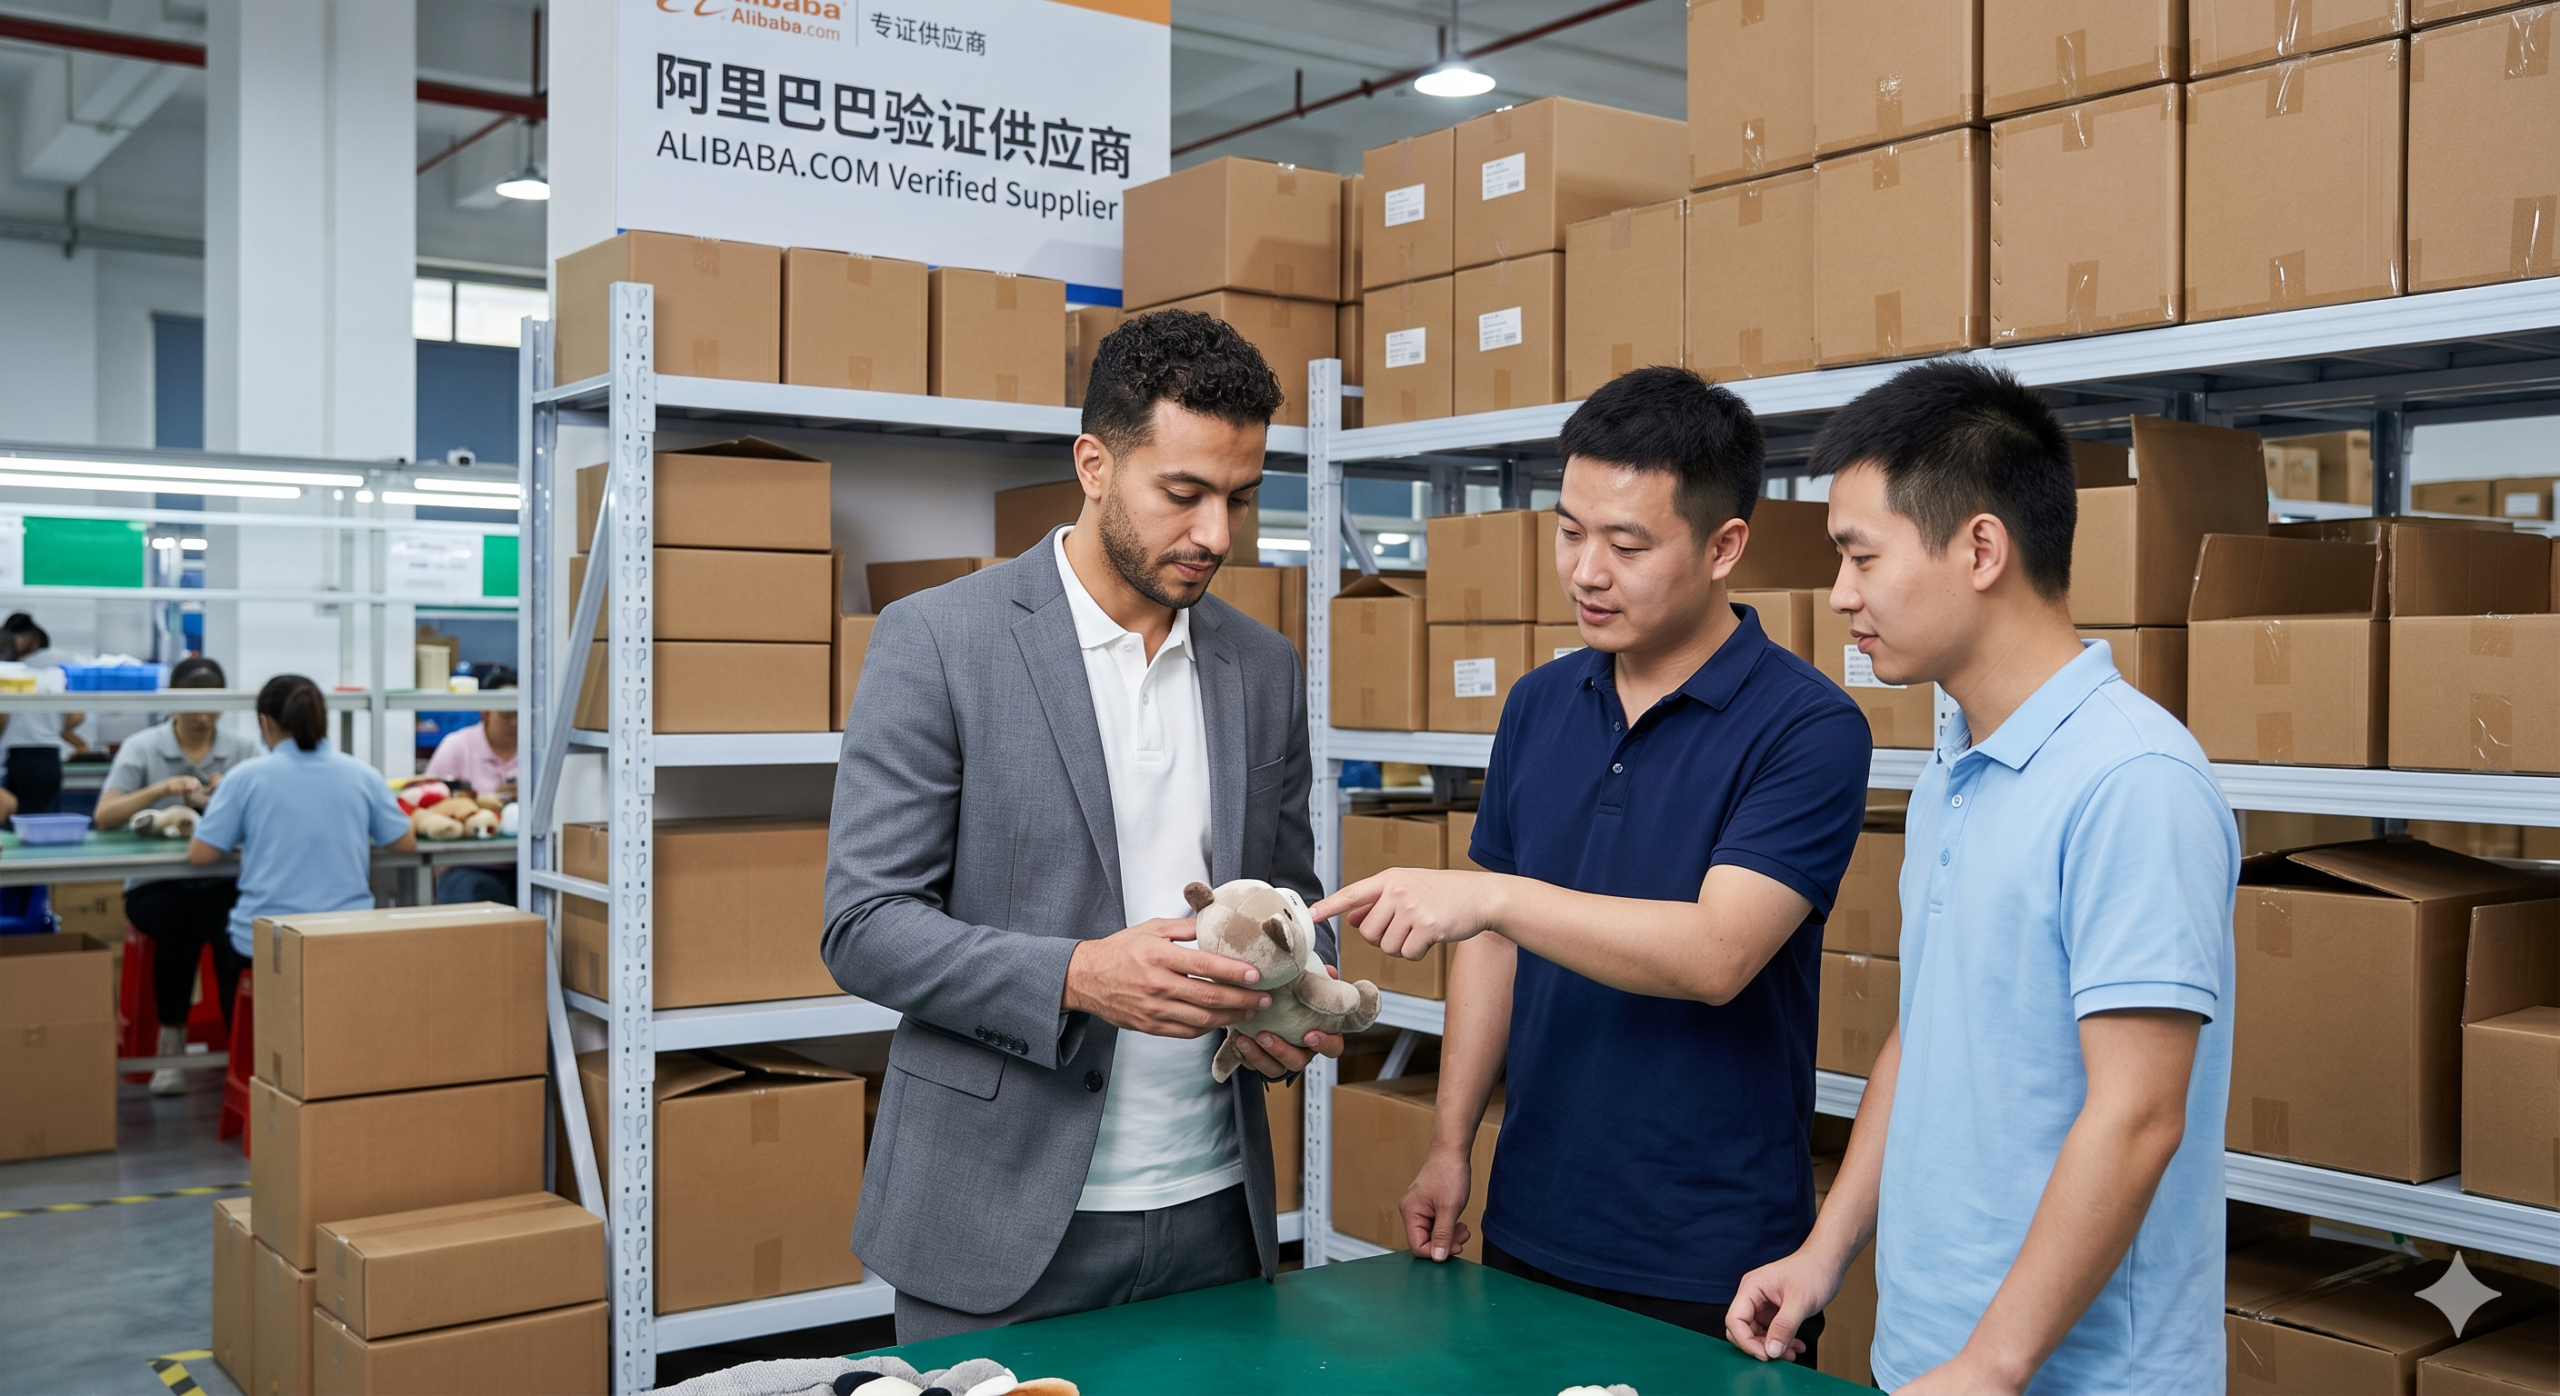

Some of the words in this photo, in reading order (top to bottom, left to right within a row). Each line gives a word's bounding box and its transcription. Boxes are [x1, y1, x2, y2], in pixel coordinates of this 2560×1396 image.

[731, 8, 840, 40] Alibaba.com
[870, 12, 986, 56] 专证供应商
[656, 53, 1131, 179] 阿里巴巴验证供应商
[656, 130, 879, 187] ALIBABA.COM
[889, 163, 996, 204] Verified
[1006, 181, 1118, 220] Supplier
